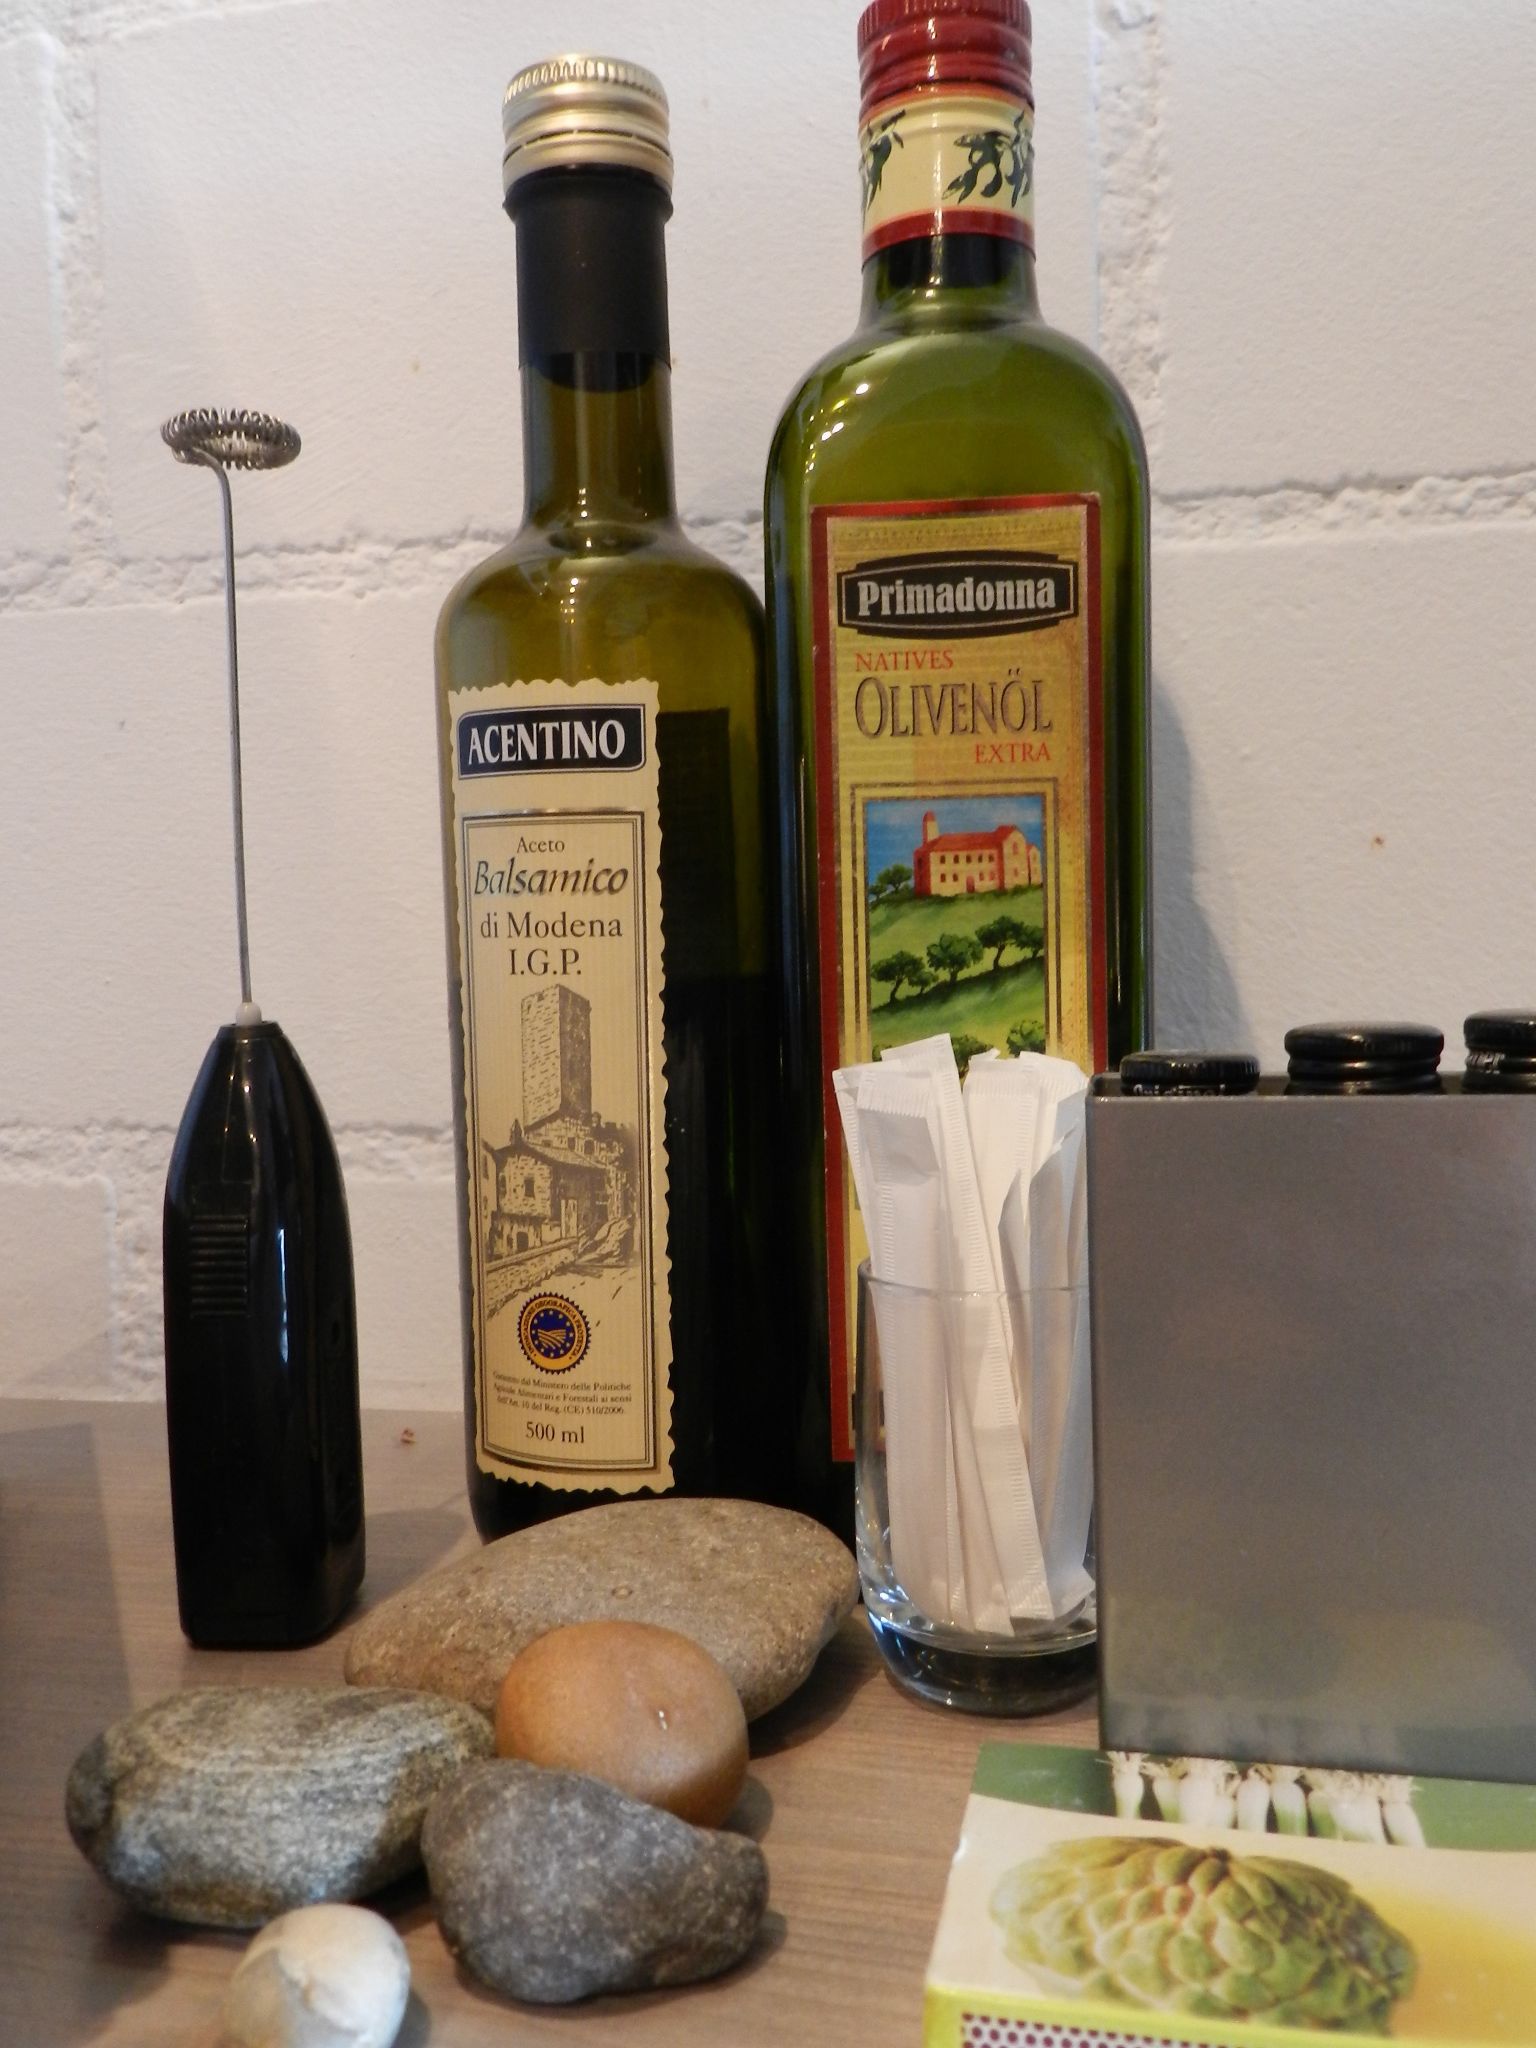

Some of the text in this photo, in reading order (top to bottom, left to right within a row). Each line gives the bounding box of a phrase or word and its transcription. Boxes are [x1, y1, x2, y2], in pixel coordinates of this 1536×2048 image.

[857, 577, 1056, 616] Primadonna
[855, 651, 954, 672] NATIVES
[855, 668, 1054, 740] OLIVENÖL
[467, 719, 626, 765] ACENTINO
[975, 742, 1051, 764] EXTRA
[516, 836, 565, 854] Aceto
[474, 856, 629, 896] Balsamico
[480, 911, 623, 939] di Modena
[509, 948, 582, 976] I.G.P.
[526, 1421, 585, 1444] 500 ml
